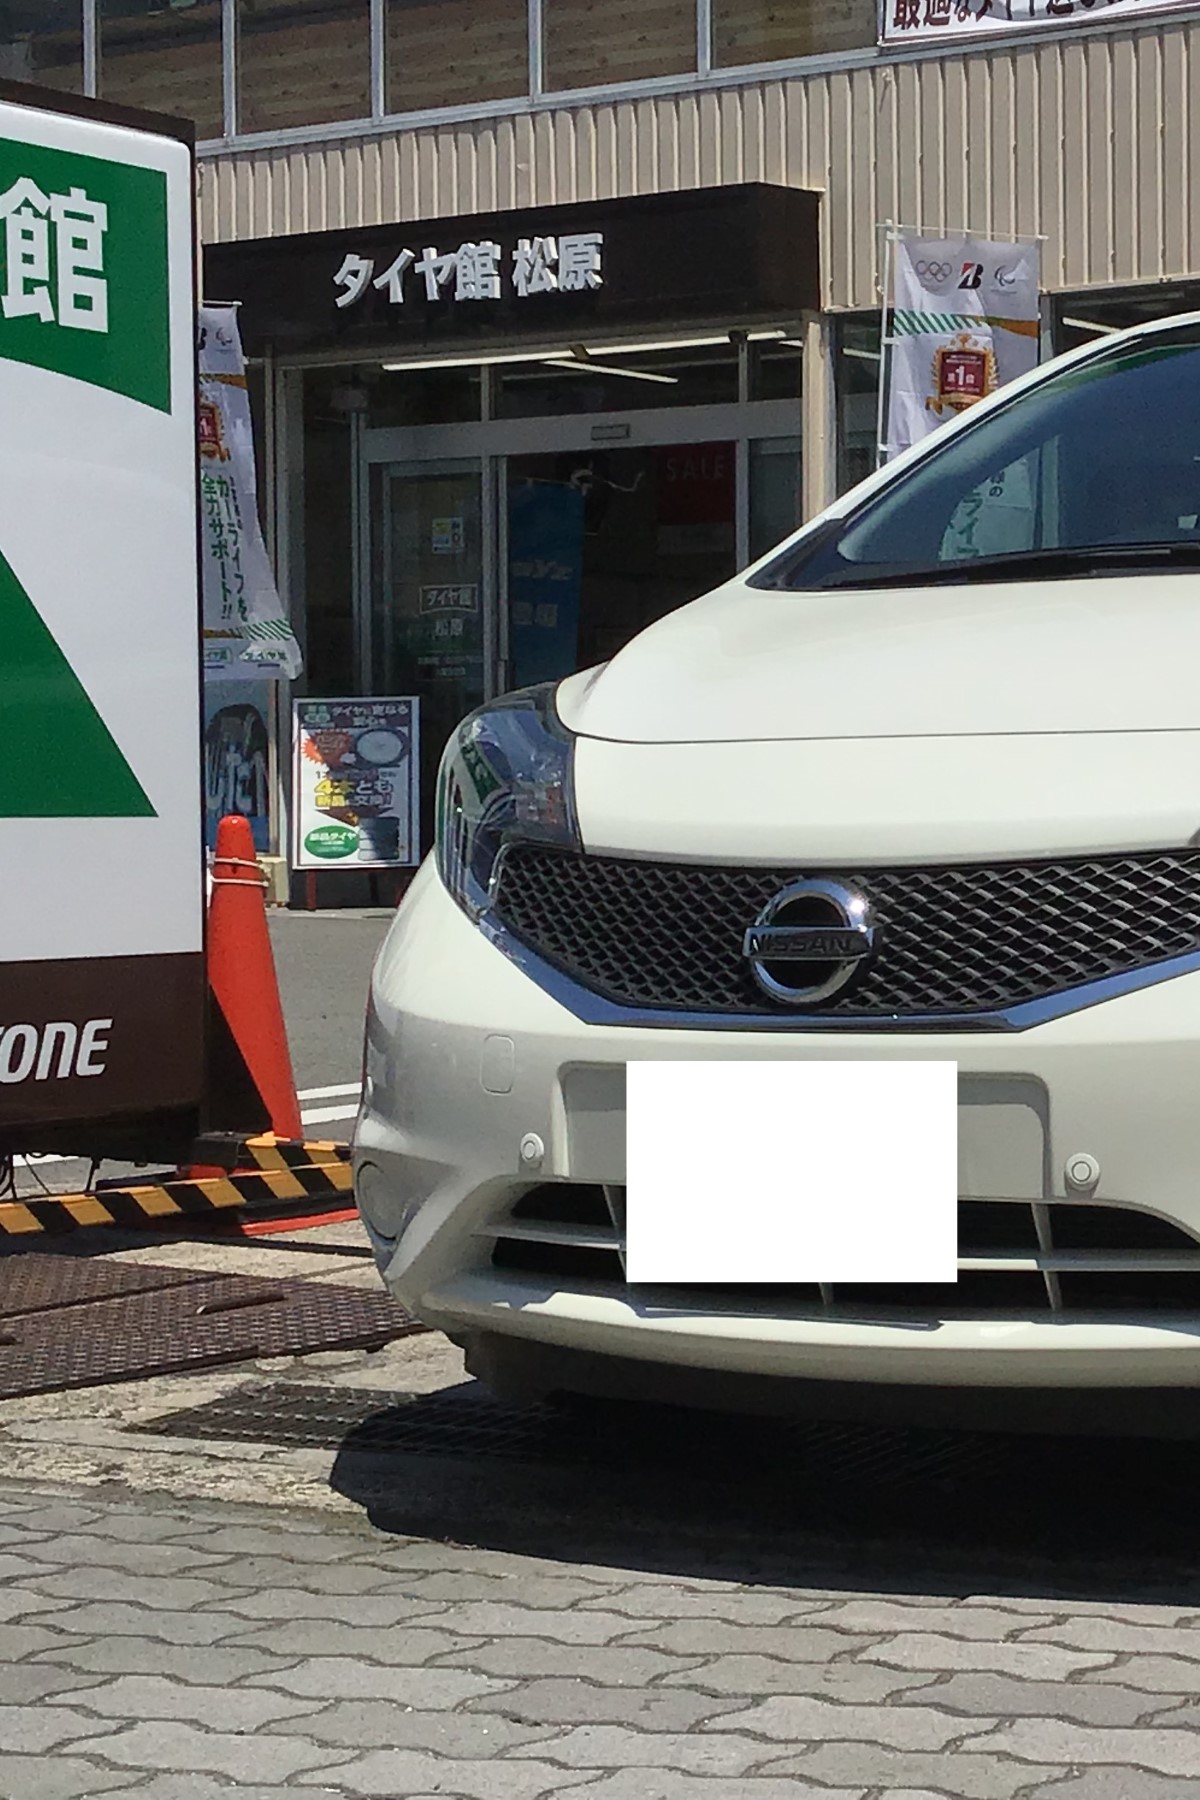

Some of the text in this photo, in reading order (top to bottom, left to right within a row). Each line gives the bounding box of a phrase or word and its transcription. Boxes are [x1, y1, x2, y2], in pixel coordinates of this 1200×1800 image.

[0, 176, 108, 333] 館
[333, 232, 603, 308] タイヤ館 松原
[666, 456, 725, 482] SALE
[426, 586, 472, 606] タイヤ館
[750, 934, 851, 954] NISSAN
[0, 1018, 113, 1084] ONE
